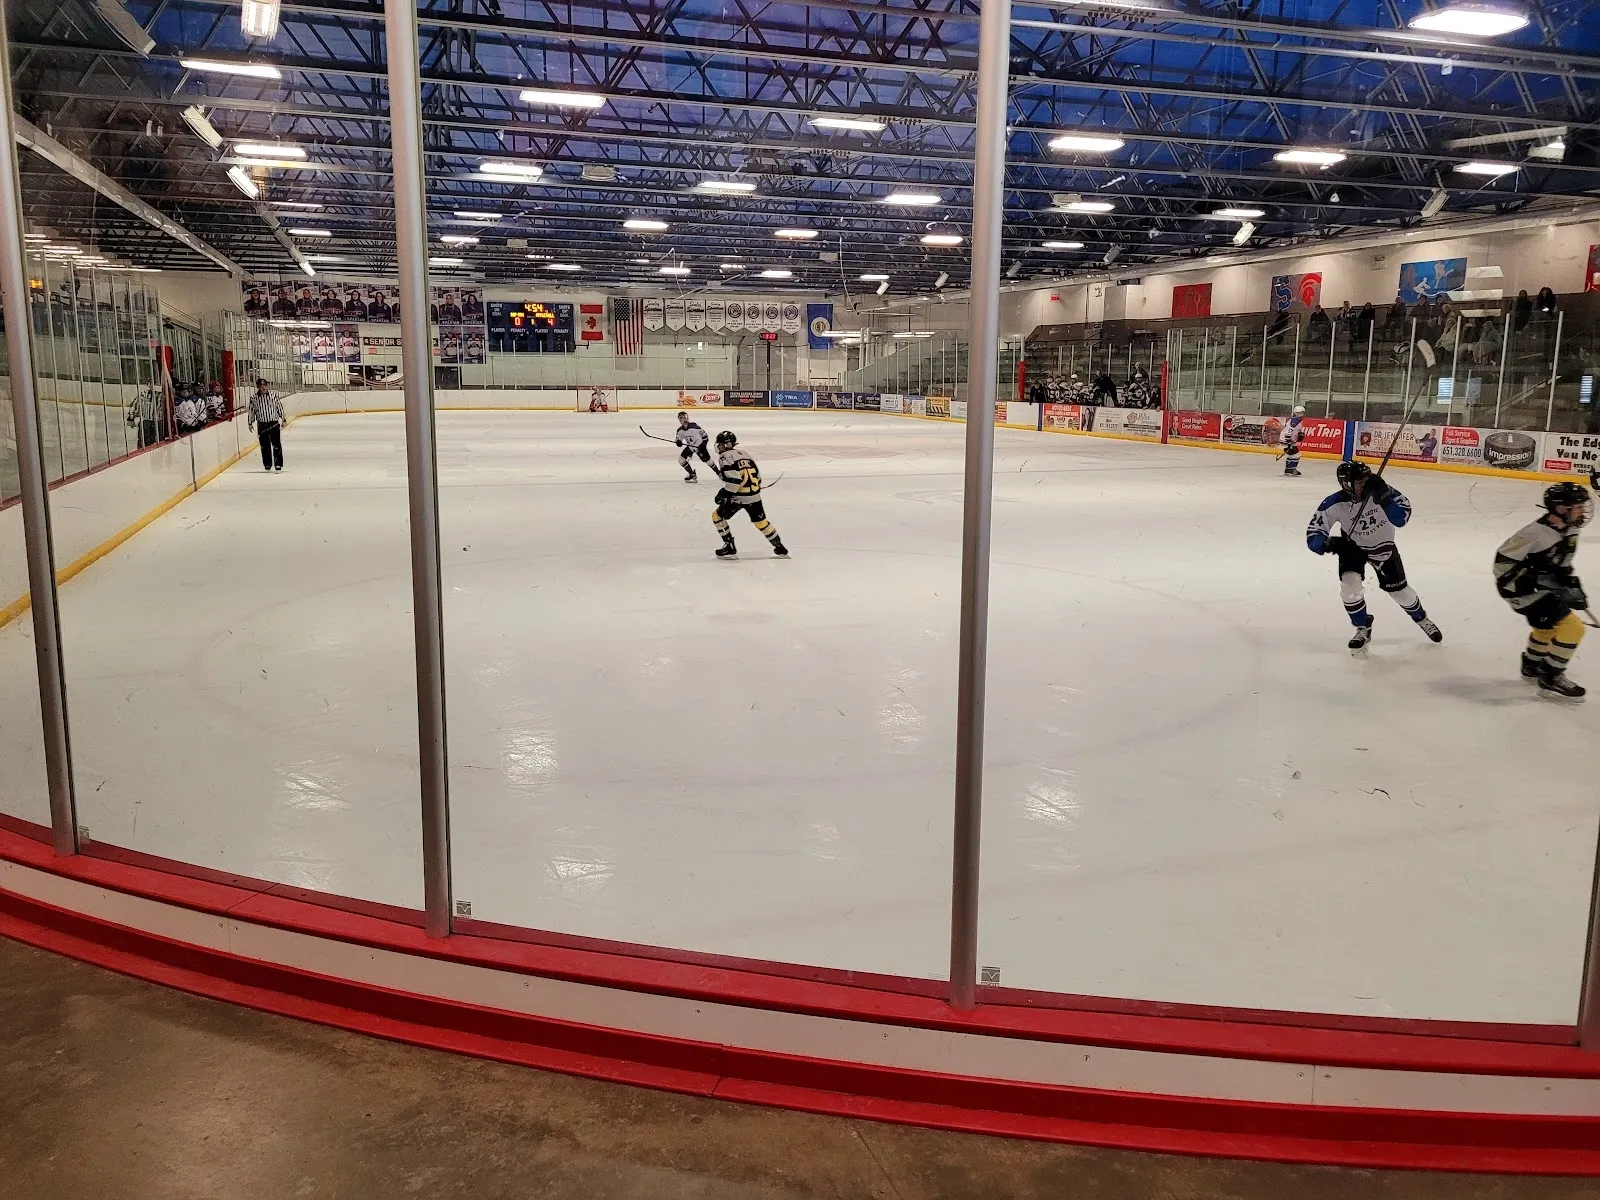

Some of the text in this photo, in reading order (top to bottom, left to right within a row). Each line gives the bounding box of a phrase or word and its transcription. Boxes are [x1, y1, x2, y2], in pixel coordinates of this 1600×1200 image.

[524, 303, 543, 312] 4:54
[514, 317, 520, 326] 0
[547, 318, 553, 326] 4
[369, 338, 395, 346] SENOR
[1316, 424, 1341, 438] TRIP
[1384, 431, 1414, 440] JENIFER
[1454, 430, 1471, 438] Service
[1559, 436, 1580, 447] The
[1488, 447, 1532, 461] impression
[1556, 448, 1598, 461] You Ne
[737, 468, 761, 492] 25
[1309, 513, 1325, 526] 24
[1359, 515, 1377, 531] 24
